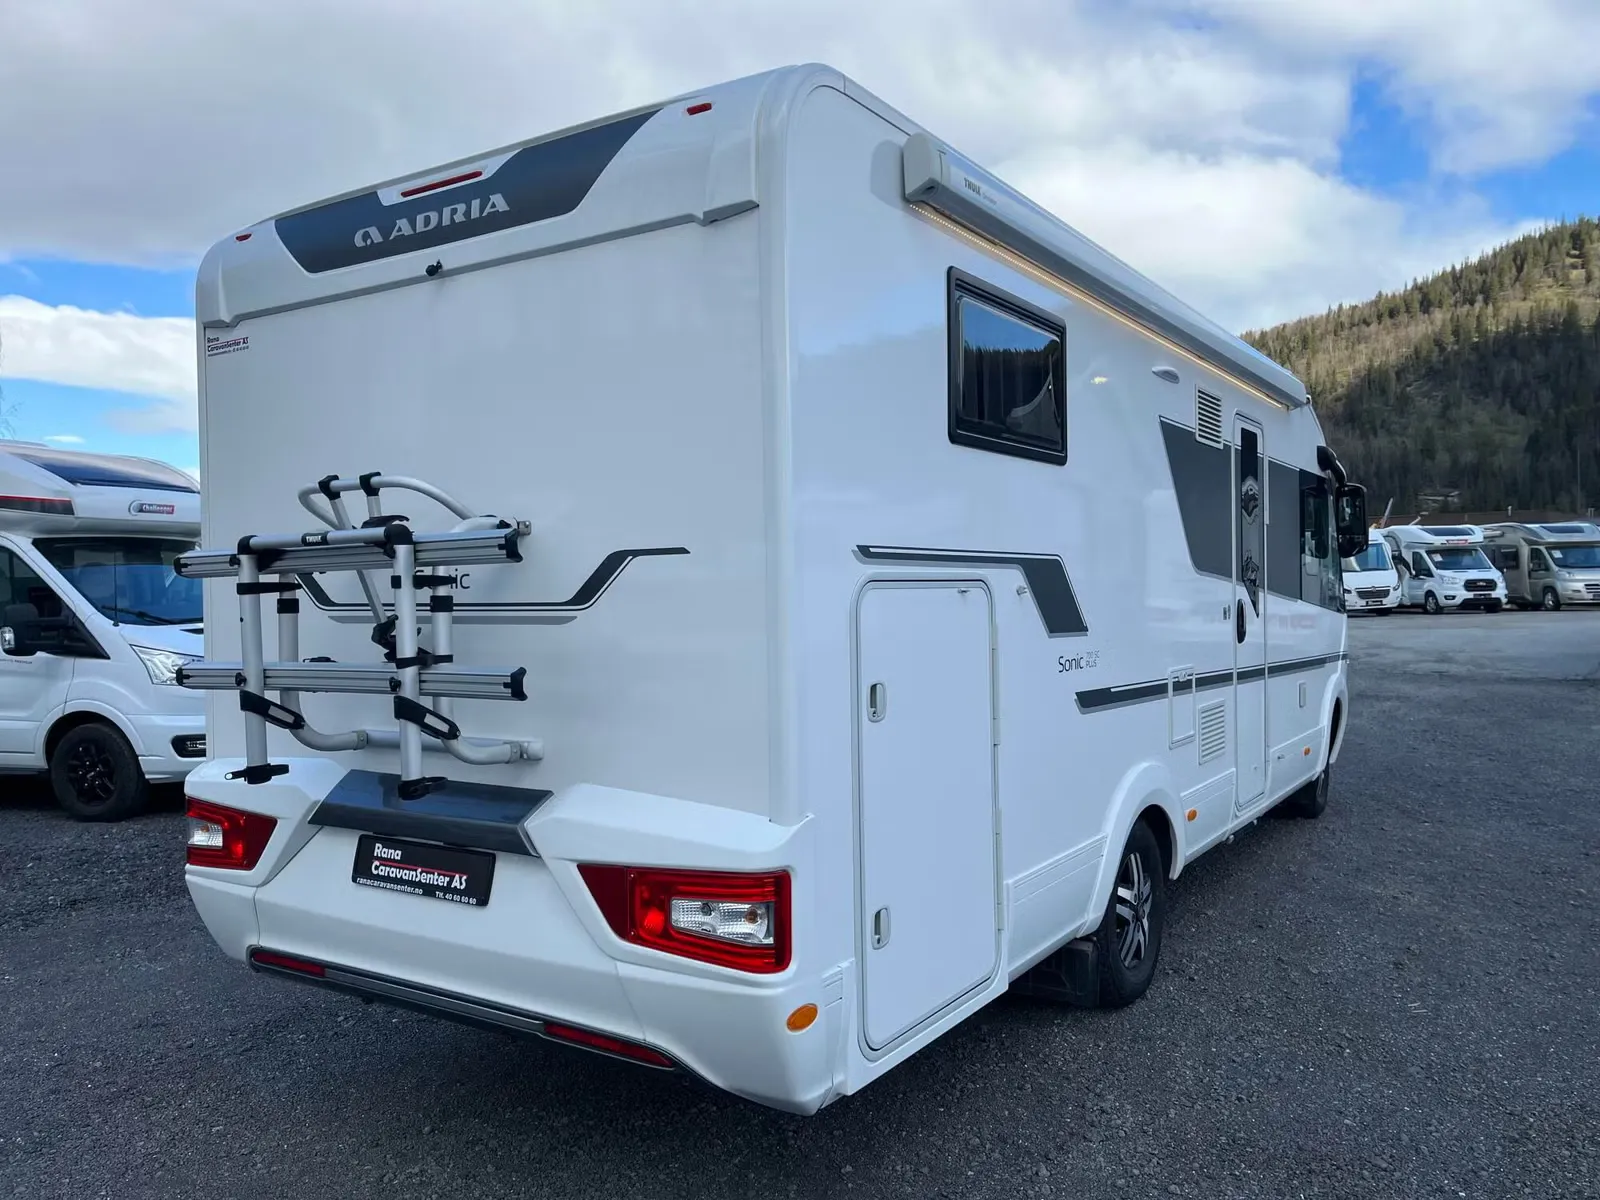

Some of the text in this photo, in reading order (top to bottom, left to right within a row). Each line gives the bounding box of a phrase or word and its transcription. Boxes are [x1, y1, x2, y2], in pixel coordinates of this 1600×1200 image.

[389, 193, 510, 240] ADRIA
[1058, 652, 1084, 673] Sonic
[373, 843, 402, 860] Rana
[371, 860, 468, 890] CaravanSenter AS
[356, 877, 424, 895] ranacaravansenter.no
[453, 894, 461, 902] 60
[469, 897, 477, 905] 60
